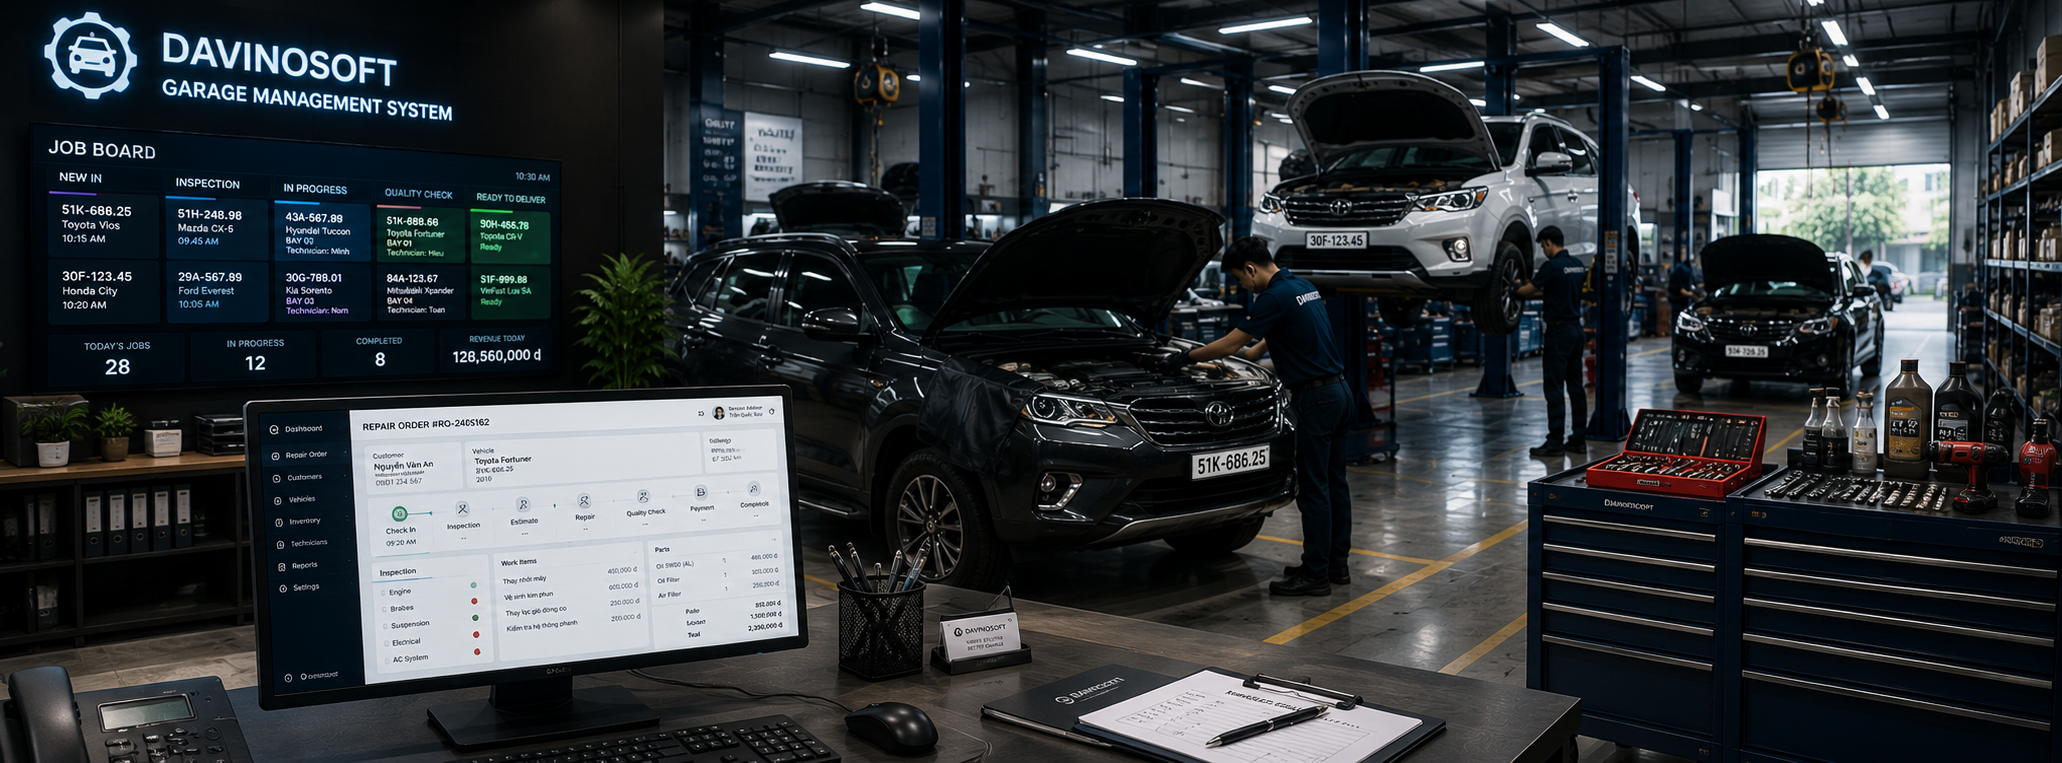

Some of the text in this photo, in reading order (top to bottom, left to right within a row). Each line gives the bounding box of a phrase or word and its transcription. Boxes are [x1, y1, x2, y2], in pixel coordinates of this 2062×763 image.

[162, 32, 398, 86] DAVINOSOFT
[162, 79, 452, 121] GARAGE MANAGEMENT SYSTEM
[48, 140, 156, 160] JOB BOARD
[59, 172, 102, 183] NEW IN
[515, 172, 550, 182] 10:30 AM
[176, 177, 241, 189] INSPECTION
[284, 184, 348, 195] IN PROGRESS
[385, 188, 453, 199] QUALITY CHECK
[477, 193, 502, 202] READY
[504, 194, 514, 202] TO
[178, 208, 242, 221] 51H-248.98
[62, 219, 96, 231] Toyota
[62, 234, 105, 243] 10:15 AM
[205, 238, 219, 246] AM
[62, 271, 132, 282] 30F-123.45
[178, 272, 242, 283] 29A-567.89
[62, 287, 118, 297] Honda City
[178, 286, 234, 295] Ford Everest
[301, 286, 332, 294] Sorento
[63, 301, 107, 309] 10:20 AM
[205, 300, 219, 308] AM
[227, 339, 285, 348] IN PROGRESS
[356, 337, 403, 346] COMPLETED
[469, 334, 525, 343] REVENUE TODAY
[84, 341, 151, 350] TODAY'S JOBS
[375, 352, 386, 367] 8
[453, 350, 531, 365] 128,560,000
[105, 359, 131, 375] 28
[245, 355, 266, 371] 12
[362, 422, 396, 431] REPAIR
[398, 420, 430, 430] ORDER
[475, 456, 532, 466] Toyota Fortuner
[1198, 449, 1266, 475] 51K-686.25
[575, 513, 595, 522] Repair
[626, 507, 666, 518] Quality Check
[385, 527, 408, 535] Check
[447, 522, 481, 531] Inspection
[380, 568, 417, 577] Inspection
[389, 588, 412, 597] Engine
[965, 623, 1007, 635] DAVINOSOFT
